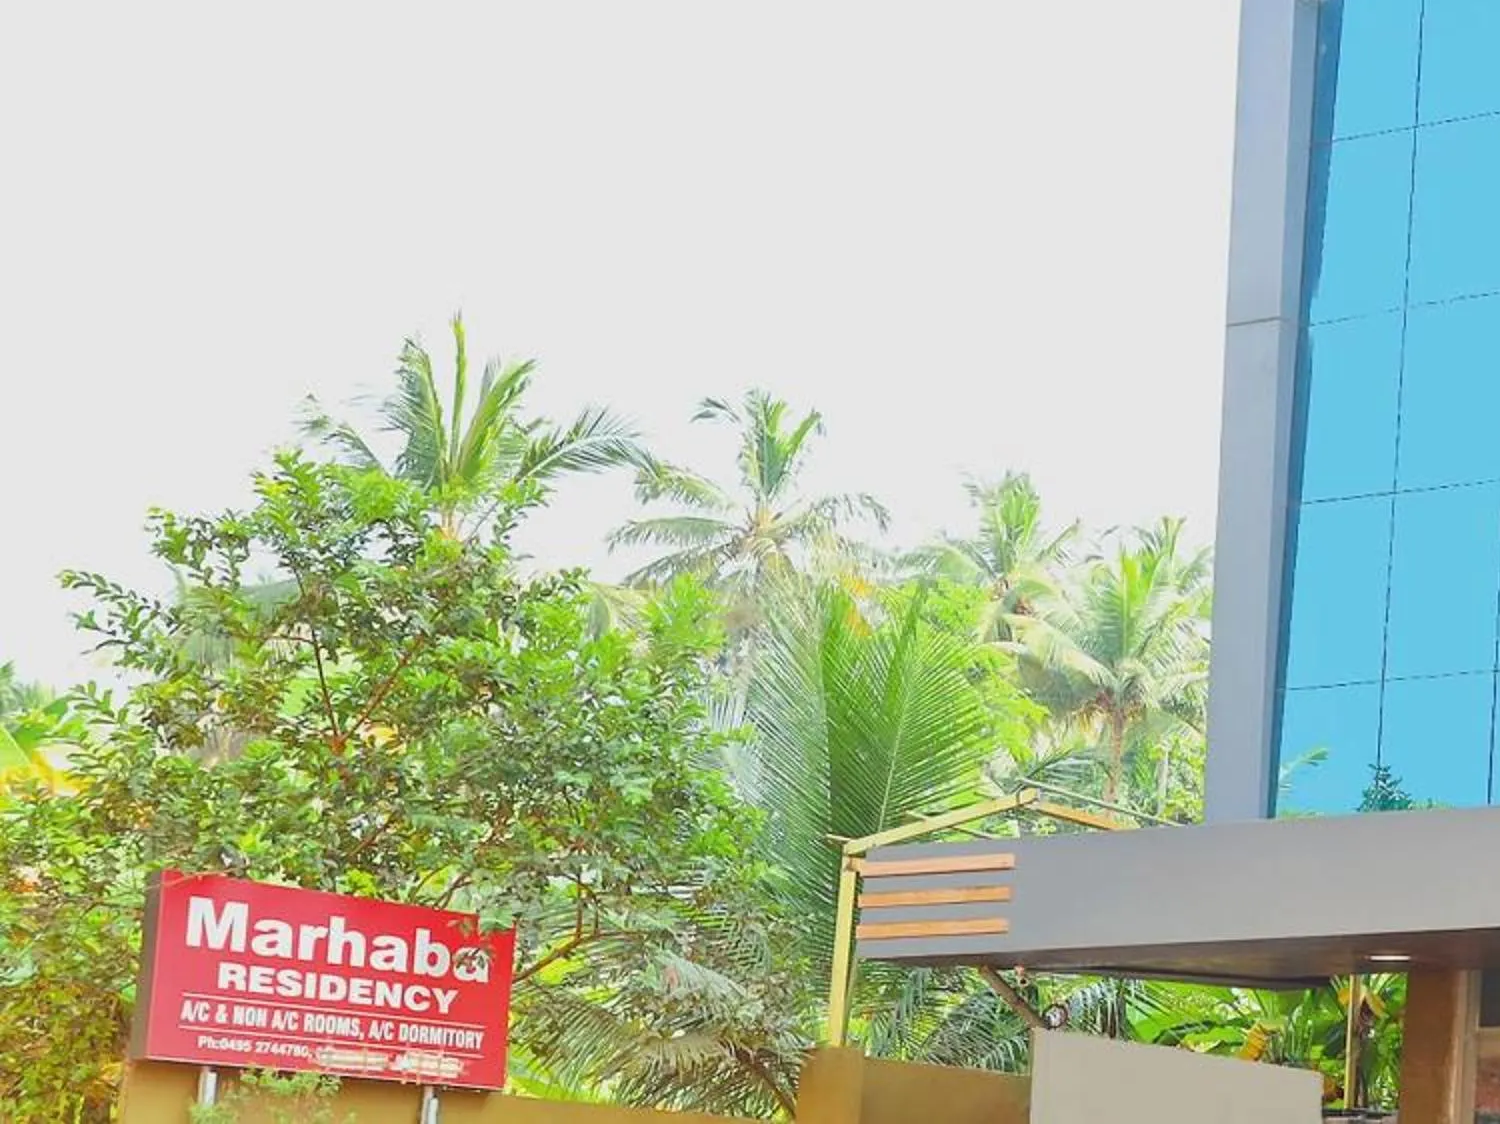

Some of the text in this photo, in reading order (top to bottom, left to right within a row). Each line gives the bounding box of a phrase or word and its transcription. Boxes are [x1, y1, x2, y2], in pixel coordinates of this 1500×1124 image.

[185, 896, 490, 983] Marhaba
[217, 961, 459, 1014] RESIDENCY
[180, 999, 485, 1050] A/C & NON A/C ROOMS, A/C DORMITORY
